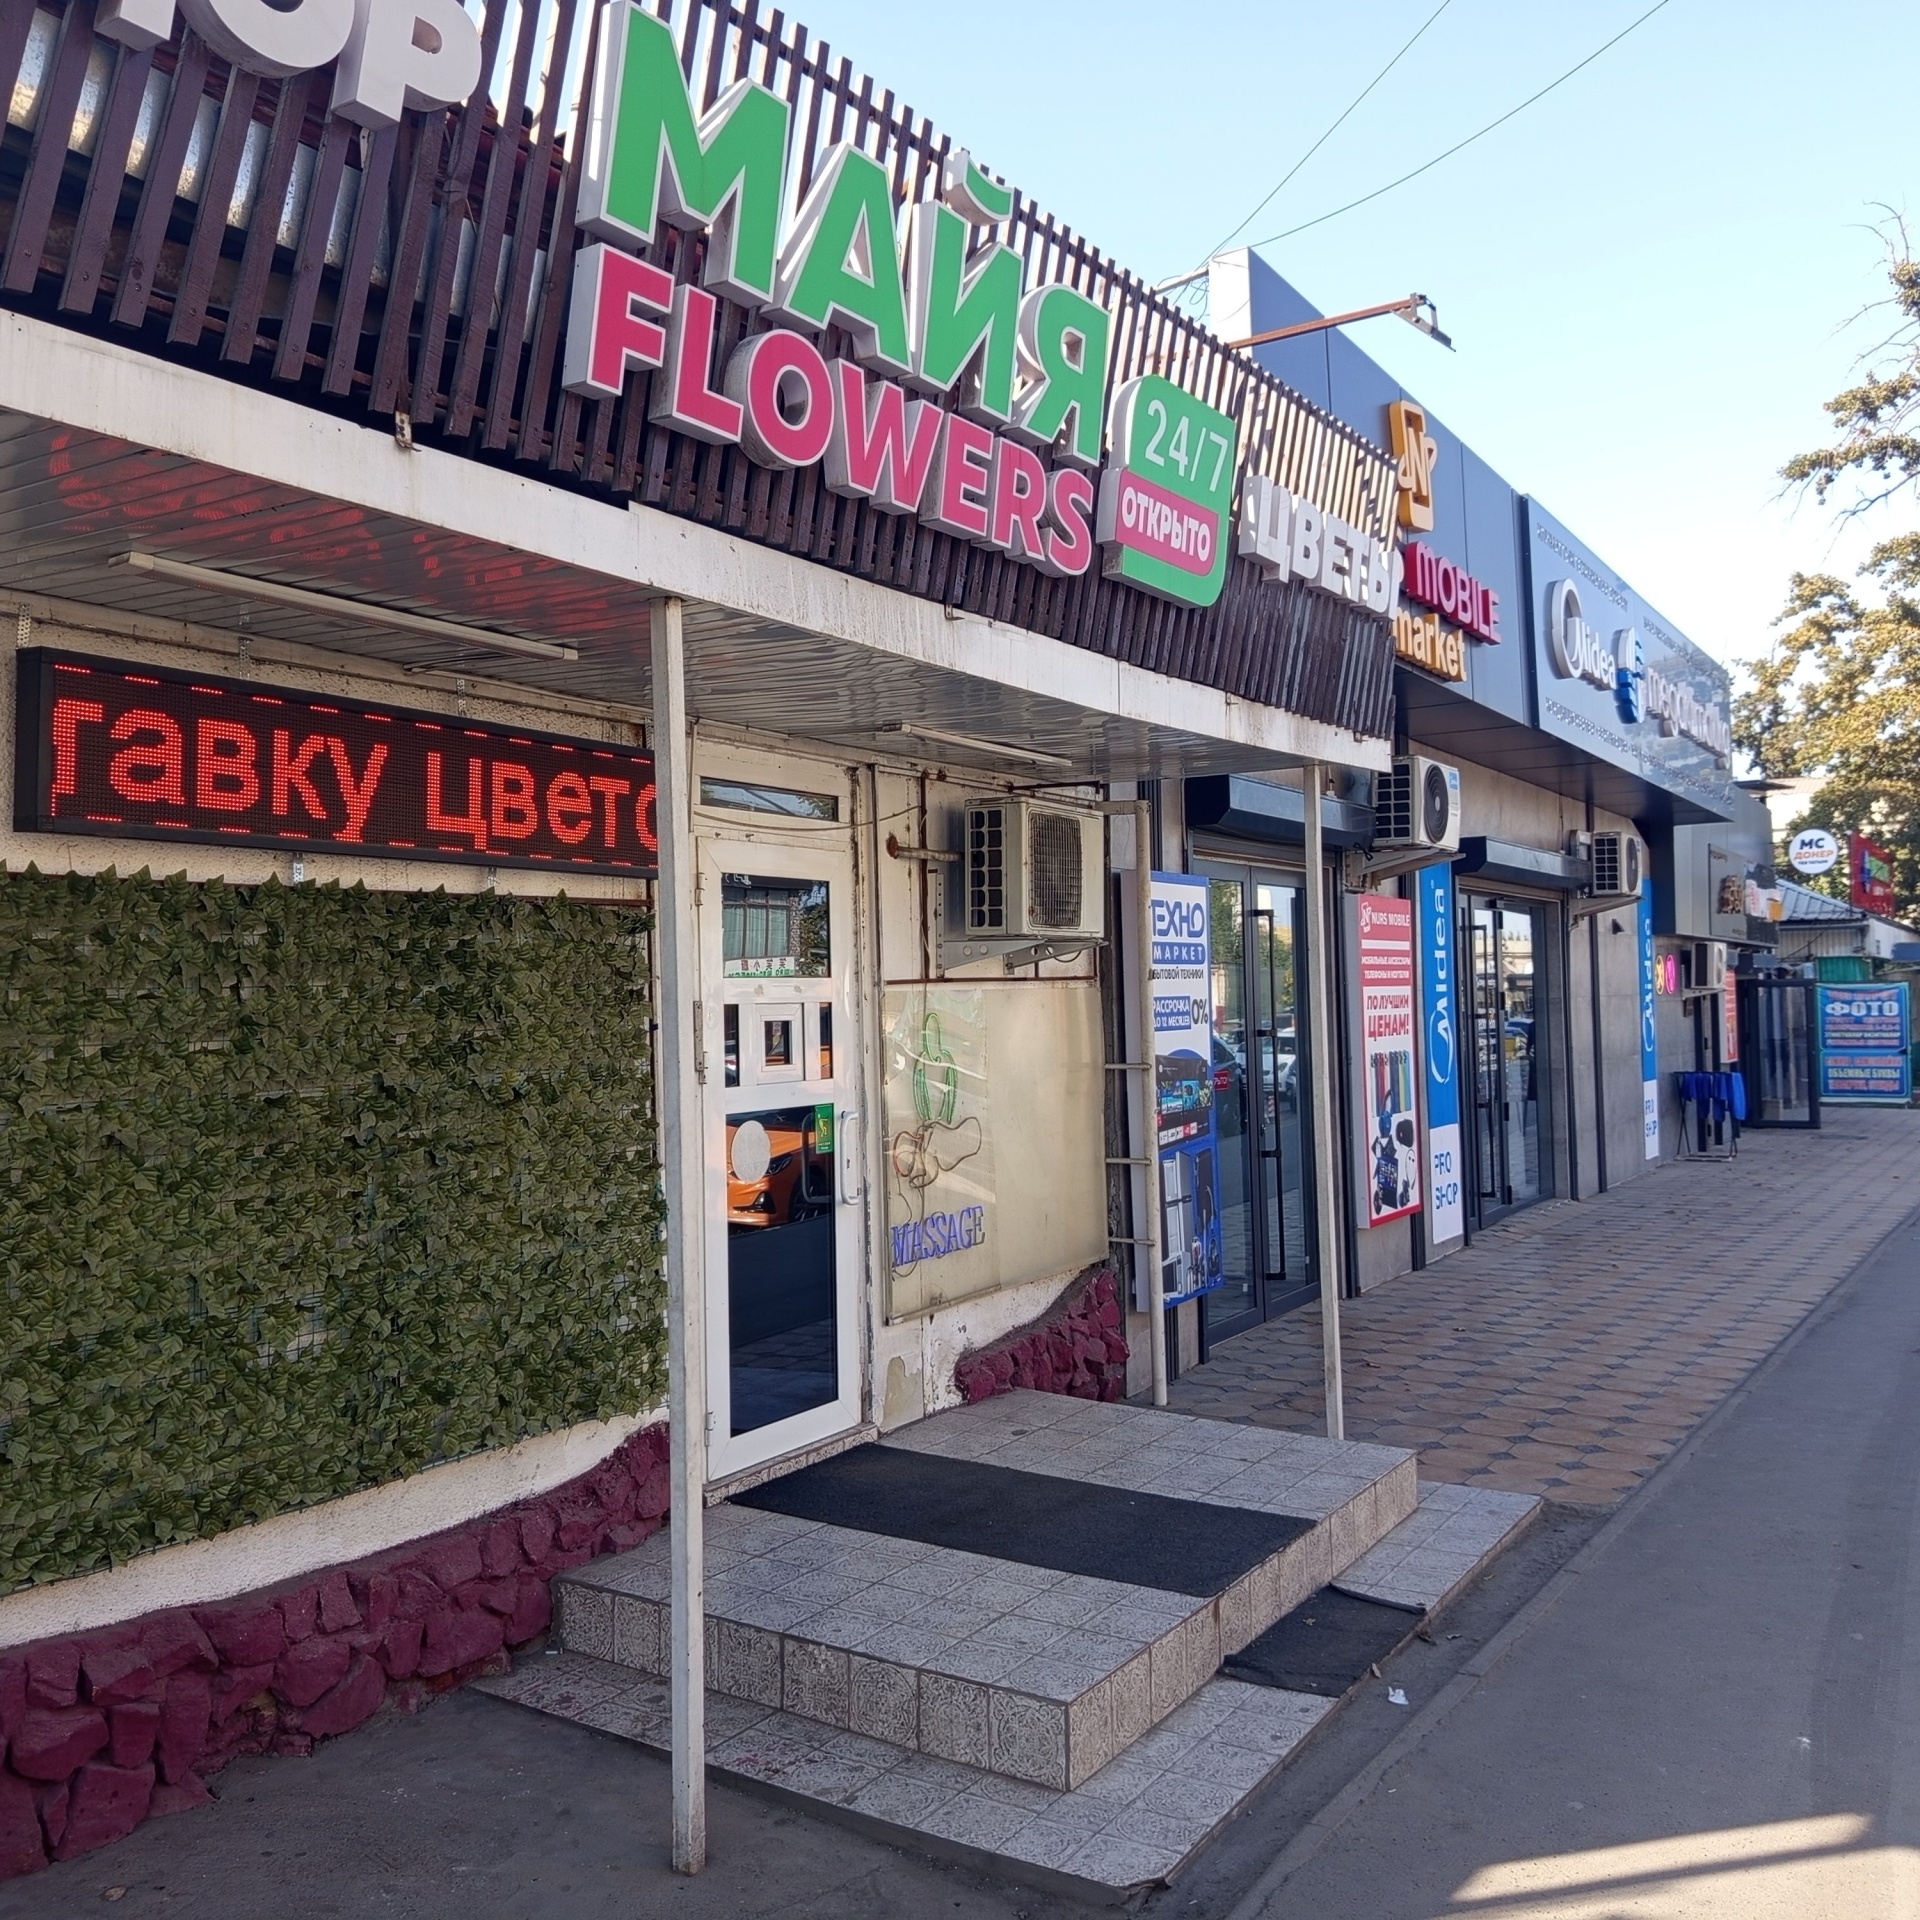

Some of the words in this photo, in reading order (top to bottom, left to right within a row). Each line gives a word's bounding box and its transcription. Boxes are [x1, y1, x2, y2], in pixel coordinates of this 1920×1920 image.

[600, 4, 1110, 467] МАЙЯ
[586, 243, 1094, 576] FLOWERS
[1145, 399, 1228, 492] 24/7
[1122, 487, 1210, 561] ОТКРЫТО
[1254, 475, 1404, 621] ЦВЕТЫ
[1416, 541, 1501, 644] MOBILE
[1393, 606, 1467, 681] market
[1558, 588, 1617, 690] Midea
[1794, 850, 1833, 860] ДОНЕР
[1371, 912, 1388, 925] NURS
[1389, 913, 1410, 926] MOBILE
[1153, 945, 1203, 961] МАРКЕТ
[1153, 966, 1179, 980] БЫТОВОЙ
[1180, 968, 1204, 980] ТЕХНИКИ
[1430, 888, 1453, 1062] Midea
[1168, 1015, 1190, 1027] МЕСЯЦЕВ
[1192, 998, 1209, 1025] 0%
[1367, 995, 1378, 1009] ПО
[1379, 995, 1409, 1009] ЛУЧШИМ
[1368, 1014, 1409, 1041] ЦЕНАМ!
[1825, 1001, 1899, 1016] ФОТО
[890, 1206, 985, 1267] MASSAGE
